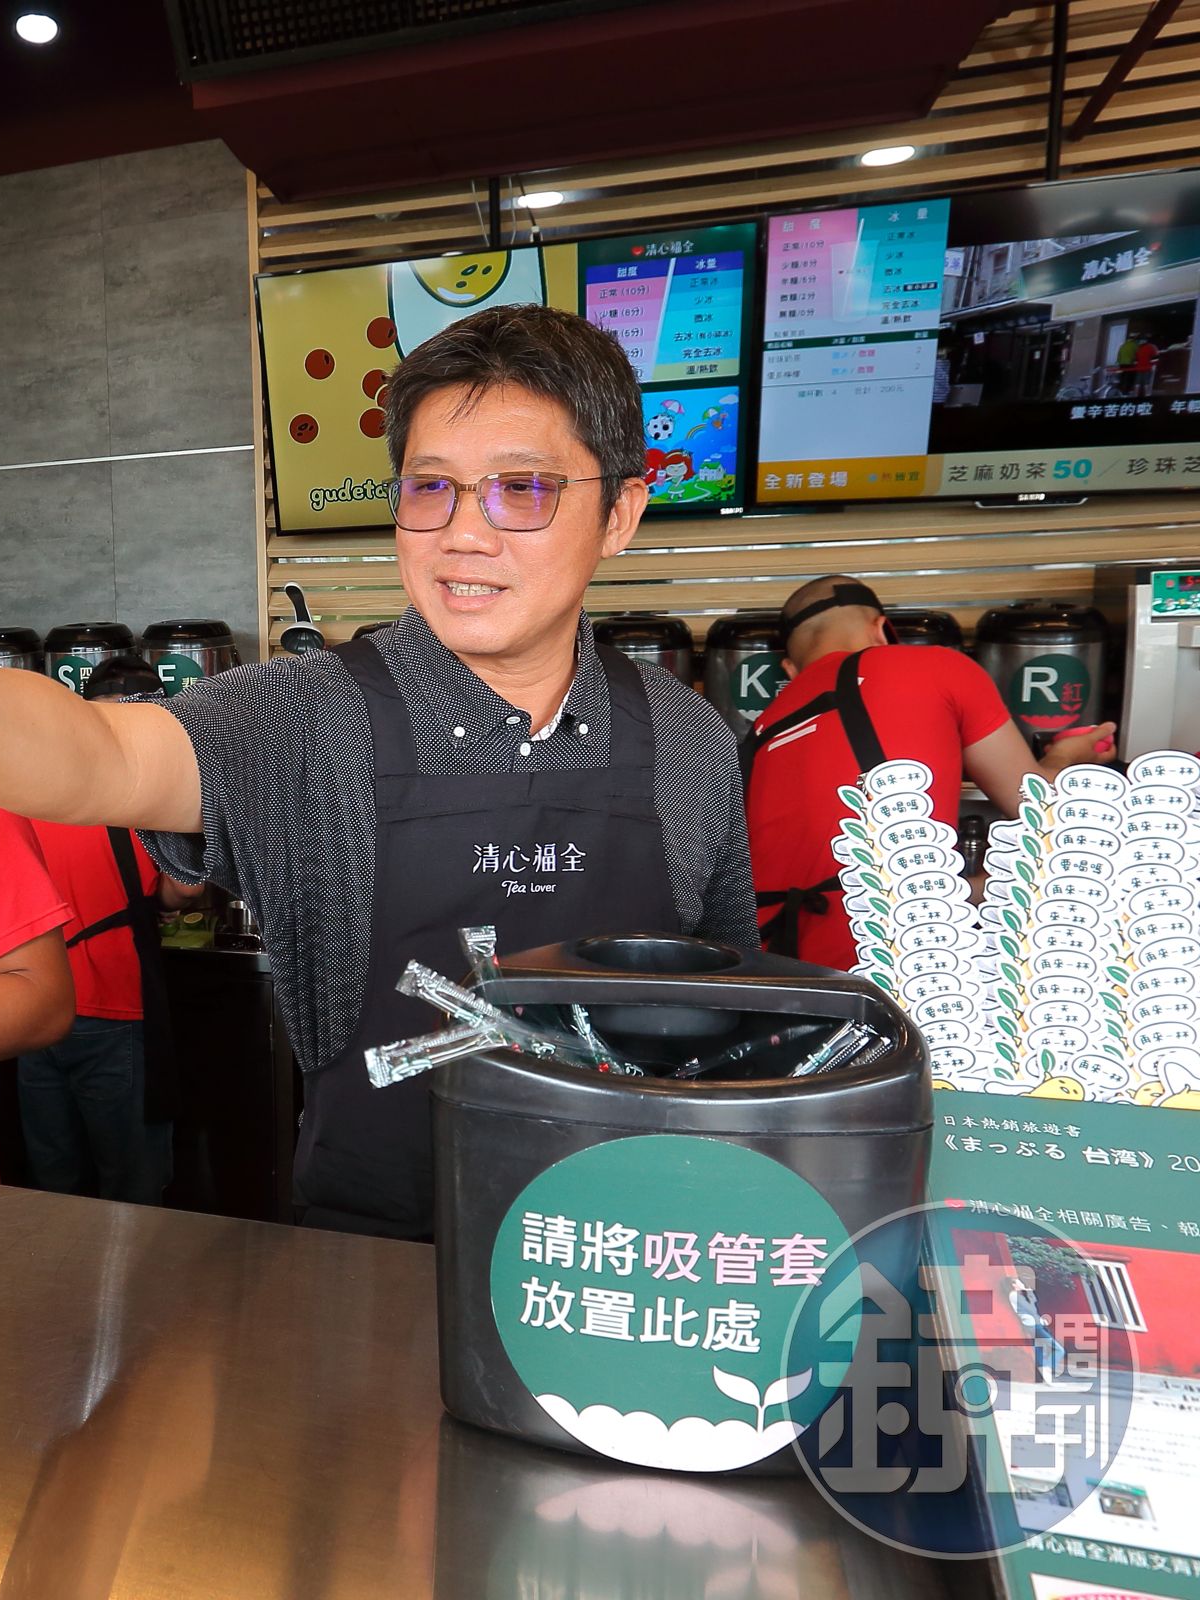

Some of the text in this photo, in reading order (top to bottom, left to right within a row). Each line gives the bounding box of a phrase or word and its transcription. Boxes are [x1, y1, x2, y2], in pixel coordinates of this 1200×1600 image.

[645, 241, 695, 256] 清心福全
[764, 471, 848, 490] 全新登場
[948, 462, 1047, 482] 芝麻奶茶
[1053, 459, 1092, 479] 50
[310, 477, 389, 511] gudeta
[740, 664, 771, 698] K
[1021, 666, 1059, 702] R
[1061, 682, 1084, 702] 紅
[472, 842, 587, 874] 清心福全
[501, 880, 527, 897] Tea
[522, 1211, 829, 1287] 請將吸管套
[520, 1277, 761, 1353] 放置此處
